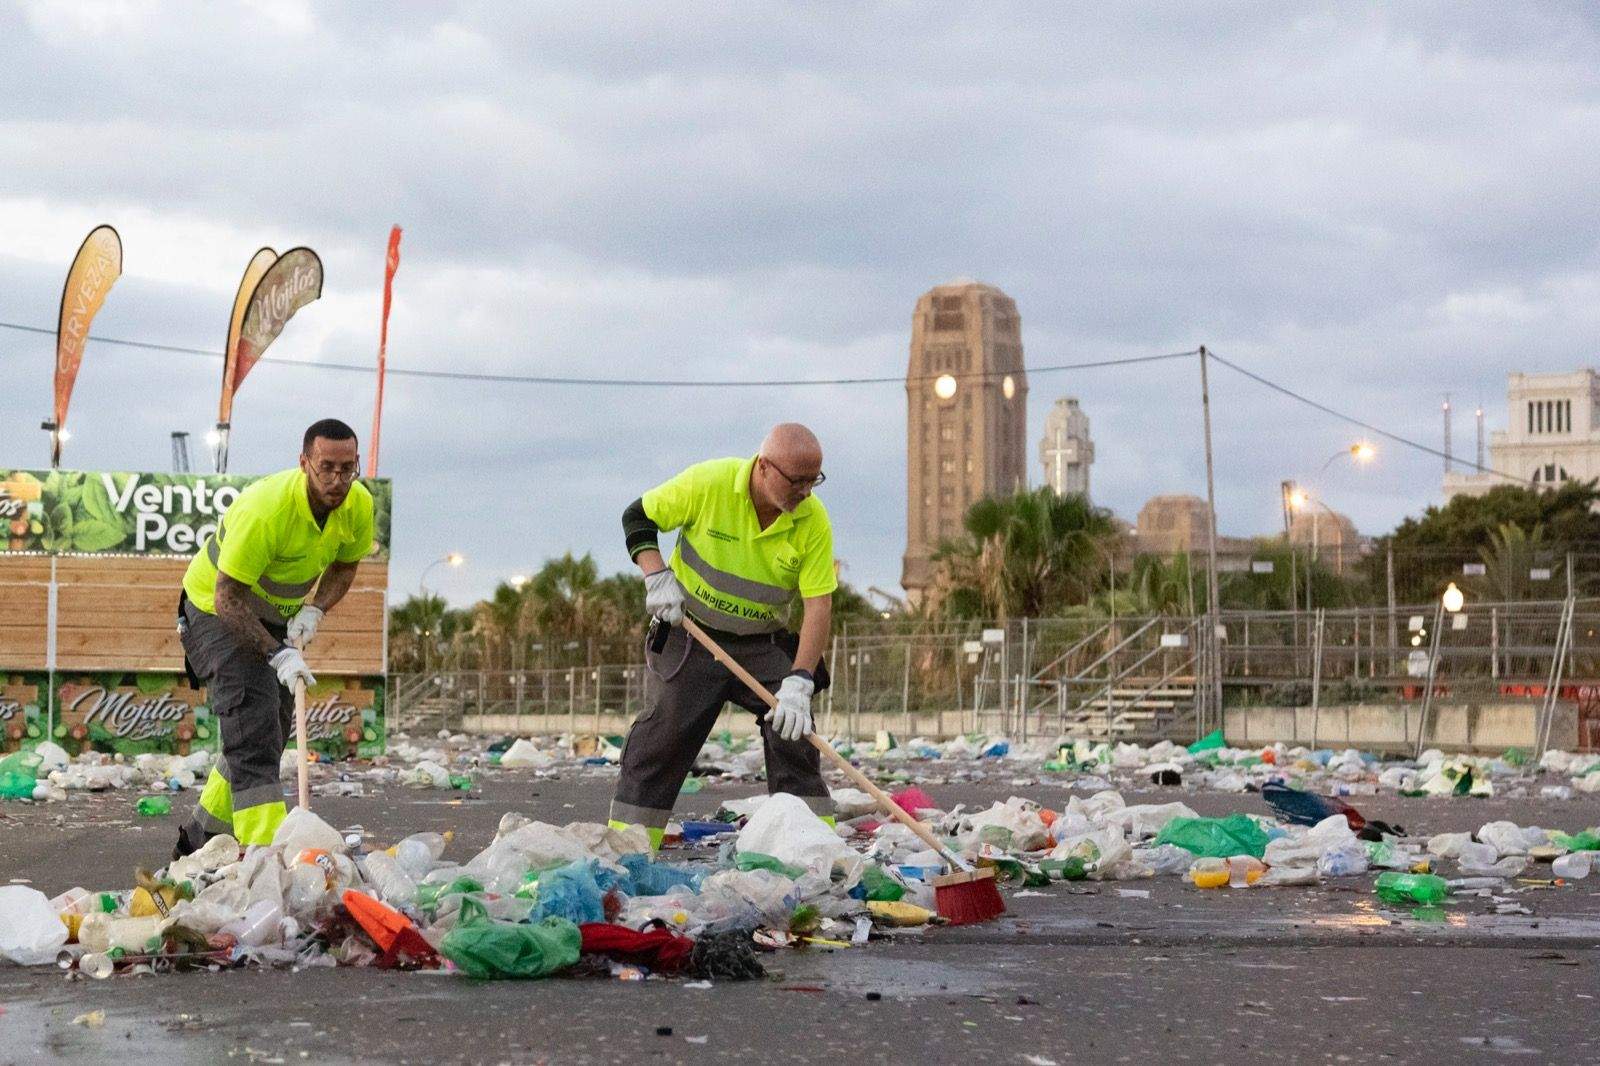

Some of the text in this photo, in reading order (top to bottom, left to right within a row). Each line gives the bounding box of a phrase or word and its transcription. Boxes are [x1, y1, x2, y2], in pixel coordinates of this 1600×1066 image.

[58, 237, 119, 374] CERVEZAS
[254, 265, 315, 334] Mojitos
[695, 585, 739, 615] LIMPIEZA
[70, 685, 193, 737] Mojitos
[130, 720, 172, 741] Bar
